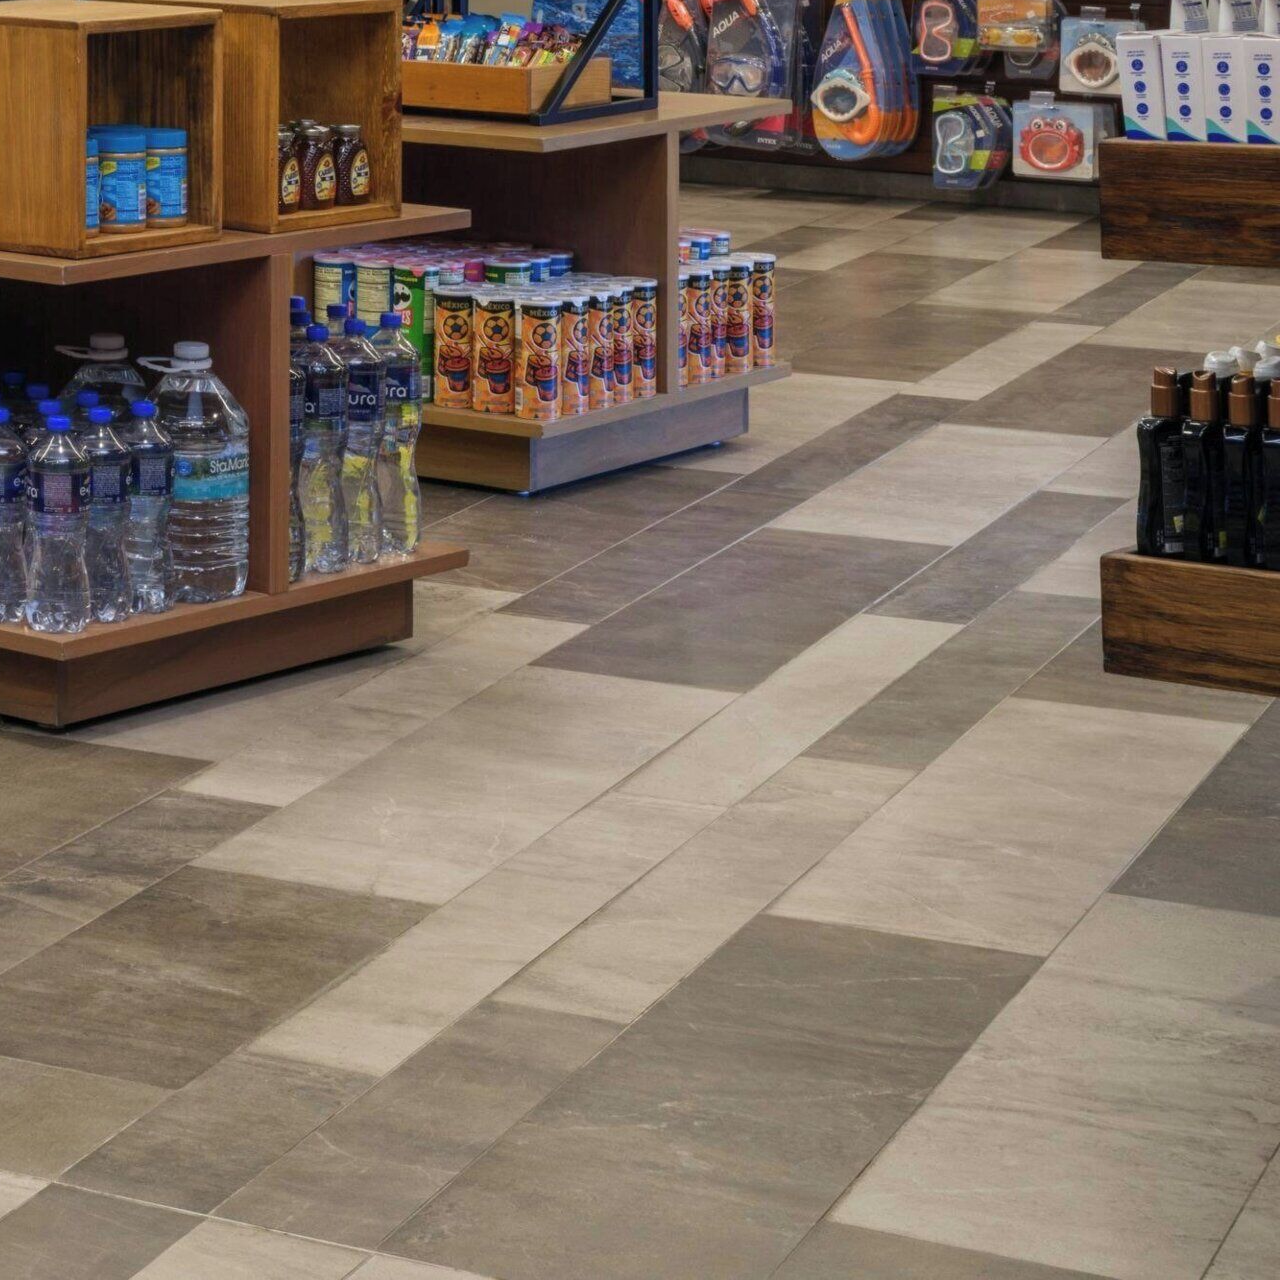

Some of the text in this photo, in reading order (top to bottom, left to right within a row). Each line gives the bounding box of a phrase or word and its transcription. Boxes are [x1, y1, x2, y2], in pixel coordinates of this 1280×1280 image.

[713, 11, 739, 38] AQUA
[821, 40, 842, 63] AQUA
[442, 300, 470, 309] MÉXICO
[530, 309, 556, 317] MÉXICO
